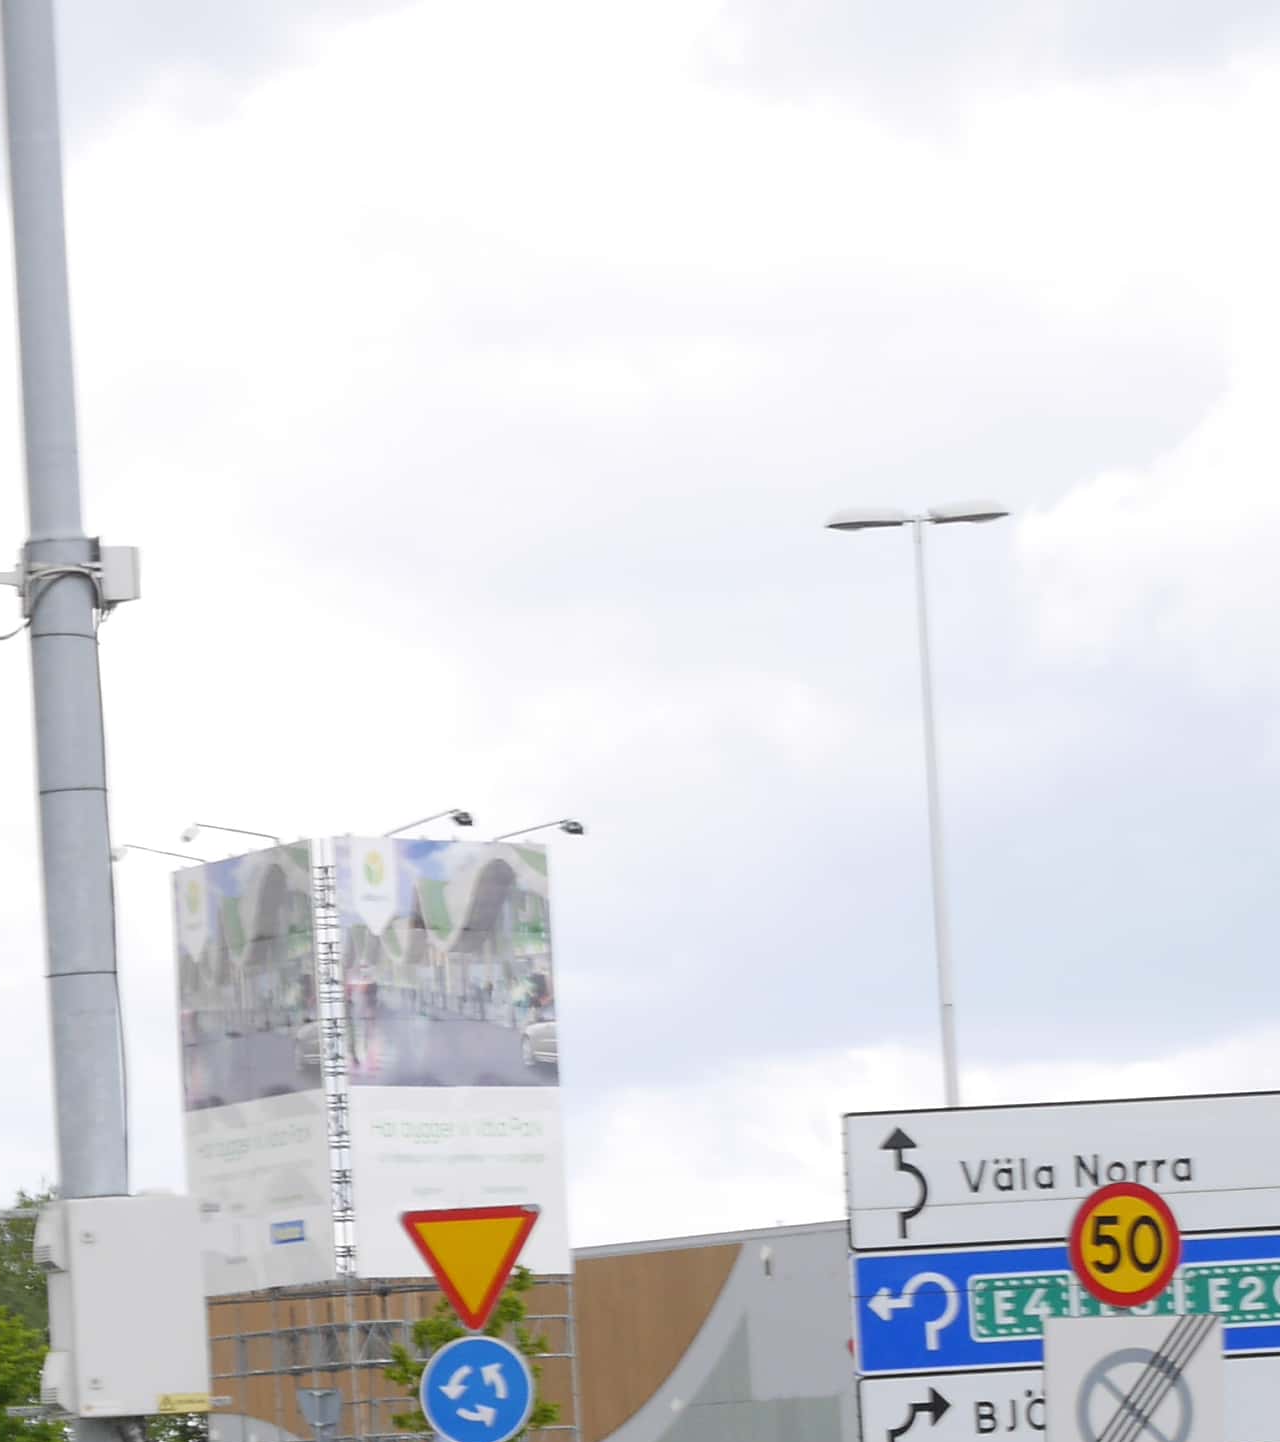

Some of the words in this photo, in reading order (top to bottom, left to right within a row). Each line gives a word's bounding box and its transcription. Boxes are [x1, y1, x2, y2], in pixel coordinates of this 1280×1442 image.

[959, 1157, 1055, 1193] Väla
[1073, 1154, 1194, 1188] Norra
[1091, 1215, 1164, 1273] 50
[992, 1288, 1055, 1325] E4
[974, 1389, 1045, 1434] BJÖ
